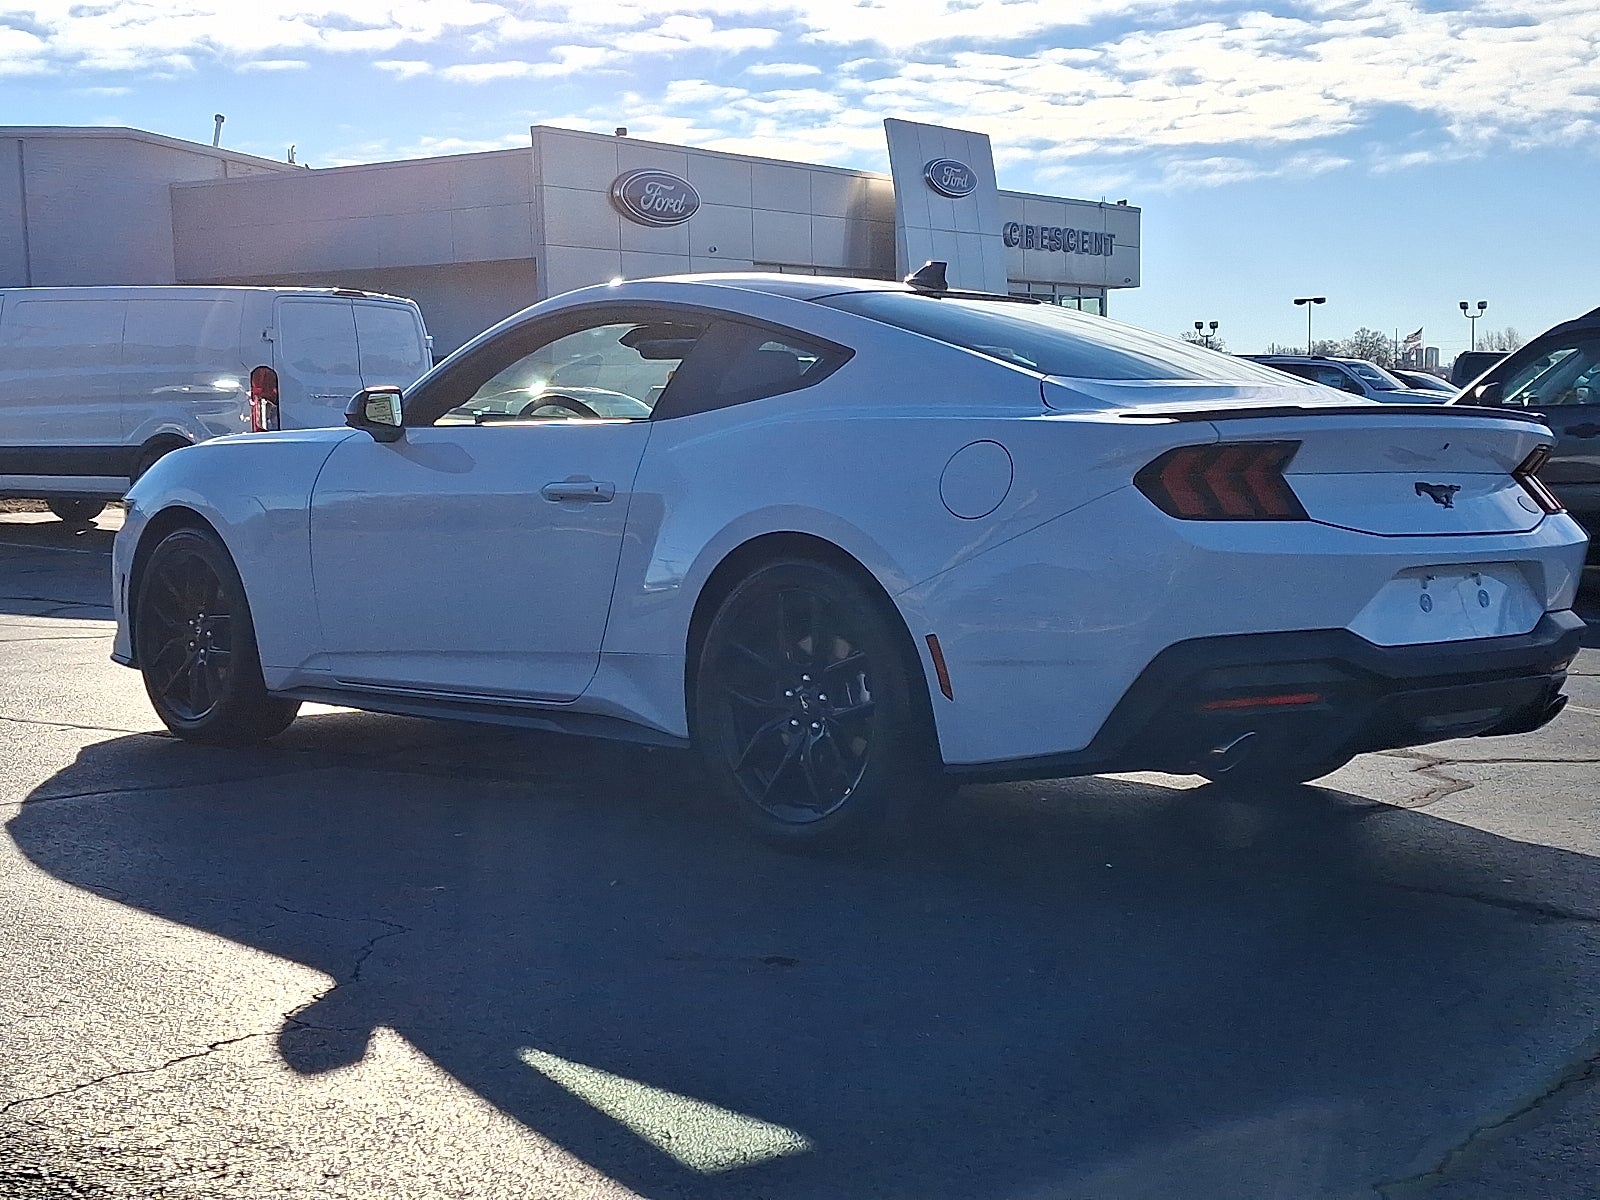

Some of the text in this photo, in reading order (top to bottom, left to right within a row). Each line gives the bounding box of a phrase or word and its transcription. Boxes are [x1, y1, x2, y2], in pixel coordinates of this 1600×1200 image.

[942, 166, 969, 188] Ford
[640, 181, 686, 214] Ford
[1003, 222, 1116, 257] CRESCENT
